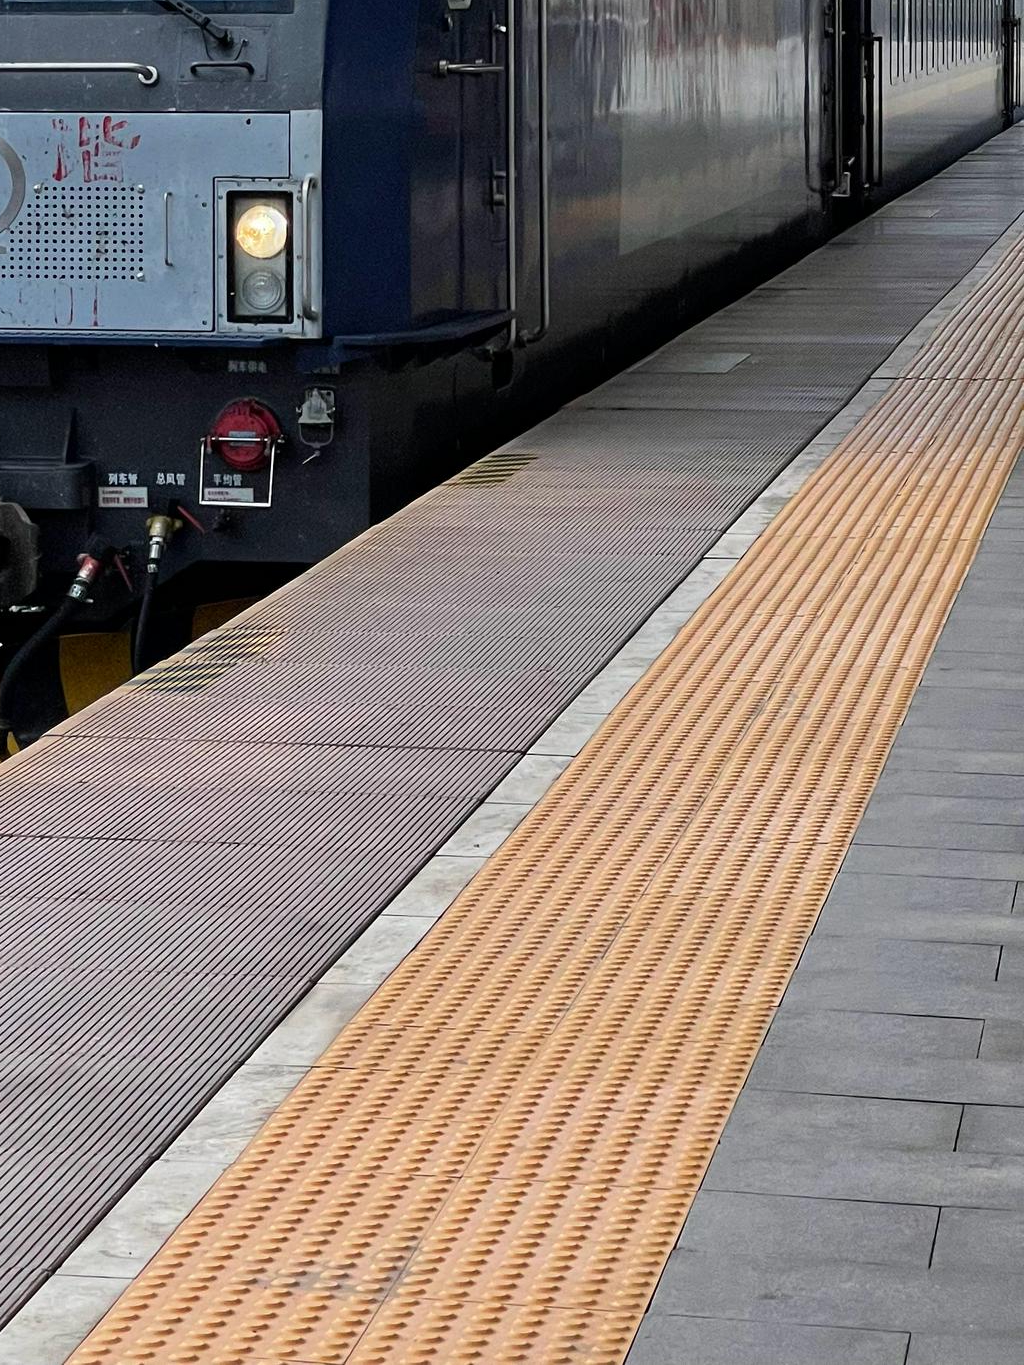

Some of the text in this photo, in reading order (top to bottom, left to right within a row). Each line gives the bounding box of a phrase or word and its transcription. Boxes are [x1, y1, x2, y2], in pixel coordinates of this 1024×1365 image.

[52, 115, 141, 183] 谐
[108, 473, 138, 485] 列车管
[156, 473, 185, 486] 总风管
[213, 474, 242, 486] 平均管
